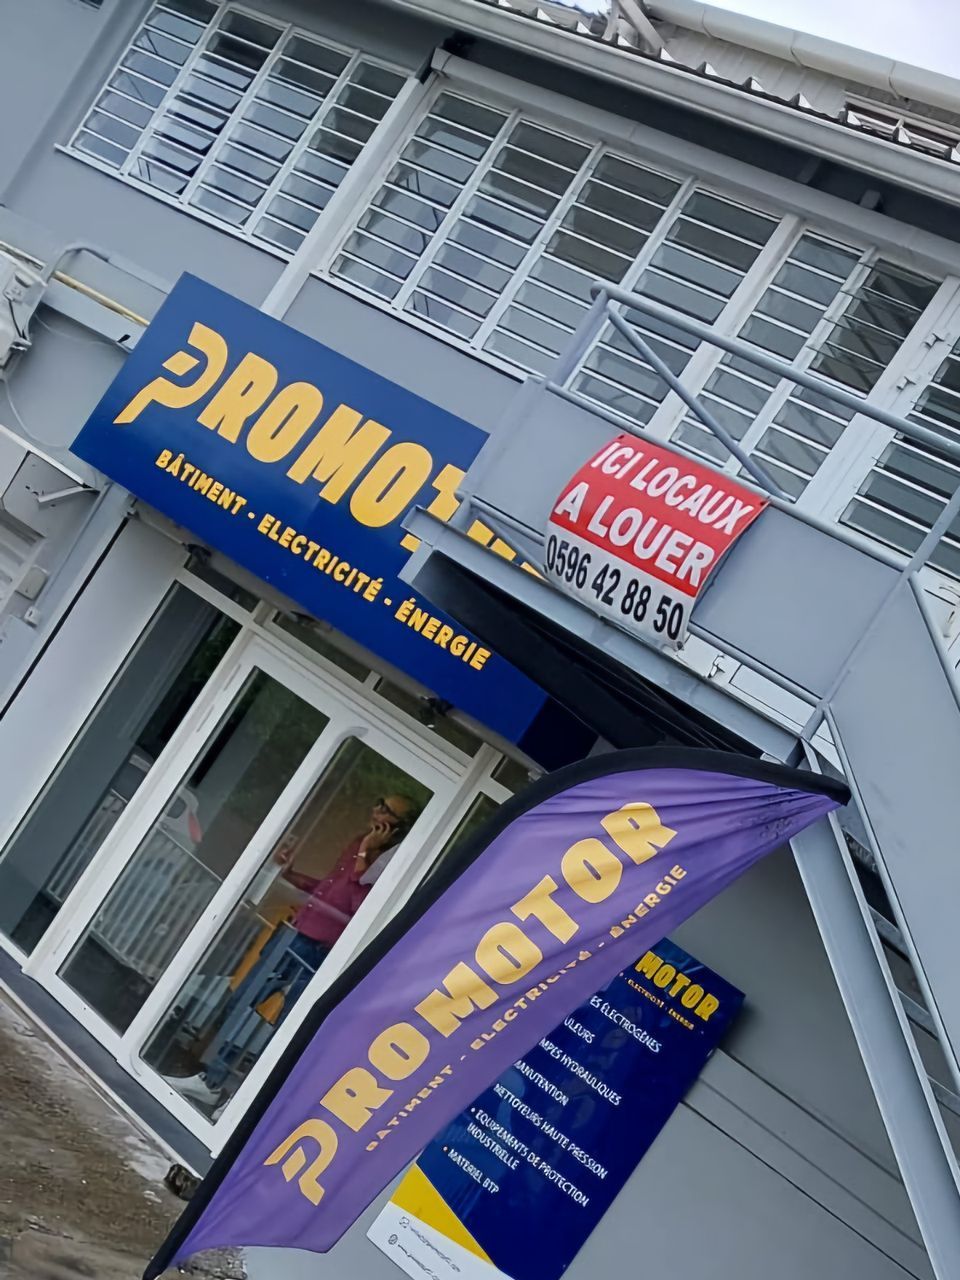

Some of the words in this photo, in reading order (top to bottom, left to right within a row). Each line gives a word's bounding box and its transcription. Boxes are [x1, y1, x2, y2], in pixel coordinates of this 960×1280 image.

[113, 321, 548, 581] PROMOT
[590, 442, 644, 479] ICI
[629, 458, 755, 536] LOCAUX
[155, 448, 248, 515] BÂTIMENT
[256, 512, 384, 600] ELECTRICITÉ
[394, 597, 493, 671] ÉNERGIE
[554, 481, 589, 523] A
[586, 495, 716, 587] LOUER
[547, 534, 592, 589] 0596
[591, 562, 622, 607] 42
[620, 578, 652, 622] 88
[653, 595, 684, 641] 50
[263, 801, 678, 1206] PROMOTOR
[634, 950, 720, 1022] MOTOR
[560, 1053, 622, 1107] HYDRAULIQUES
[466, 1122, 520, 1171] INDUSTRIELLE
[493, 1083, 544, 1127] NETTOYEURS
[541, 1121, 570, 1149] HAUTE
[567, 1143, 608, 1180] PRESSION
[482, 1177, 500, 1195] BTP
[526, 1152, 541, 1167] DE
[538, 1161, 590, 1208] PROTECTION
